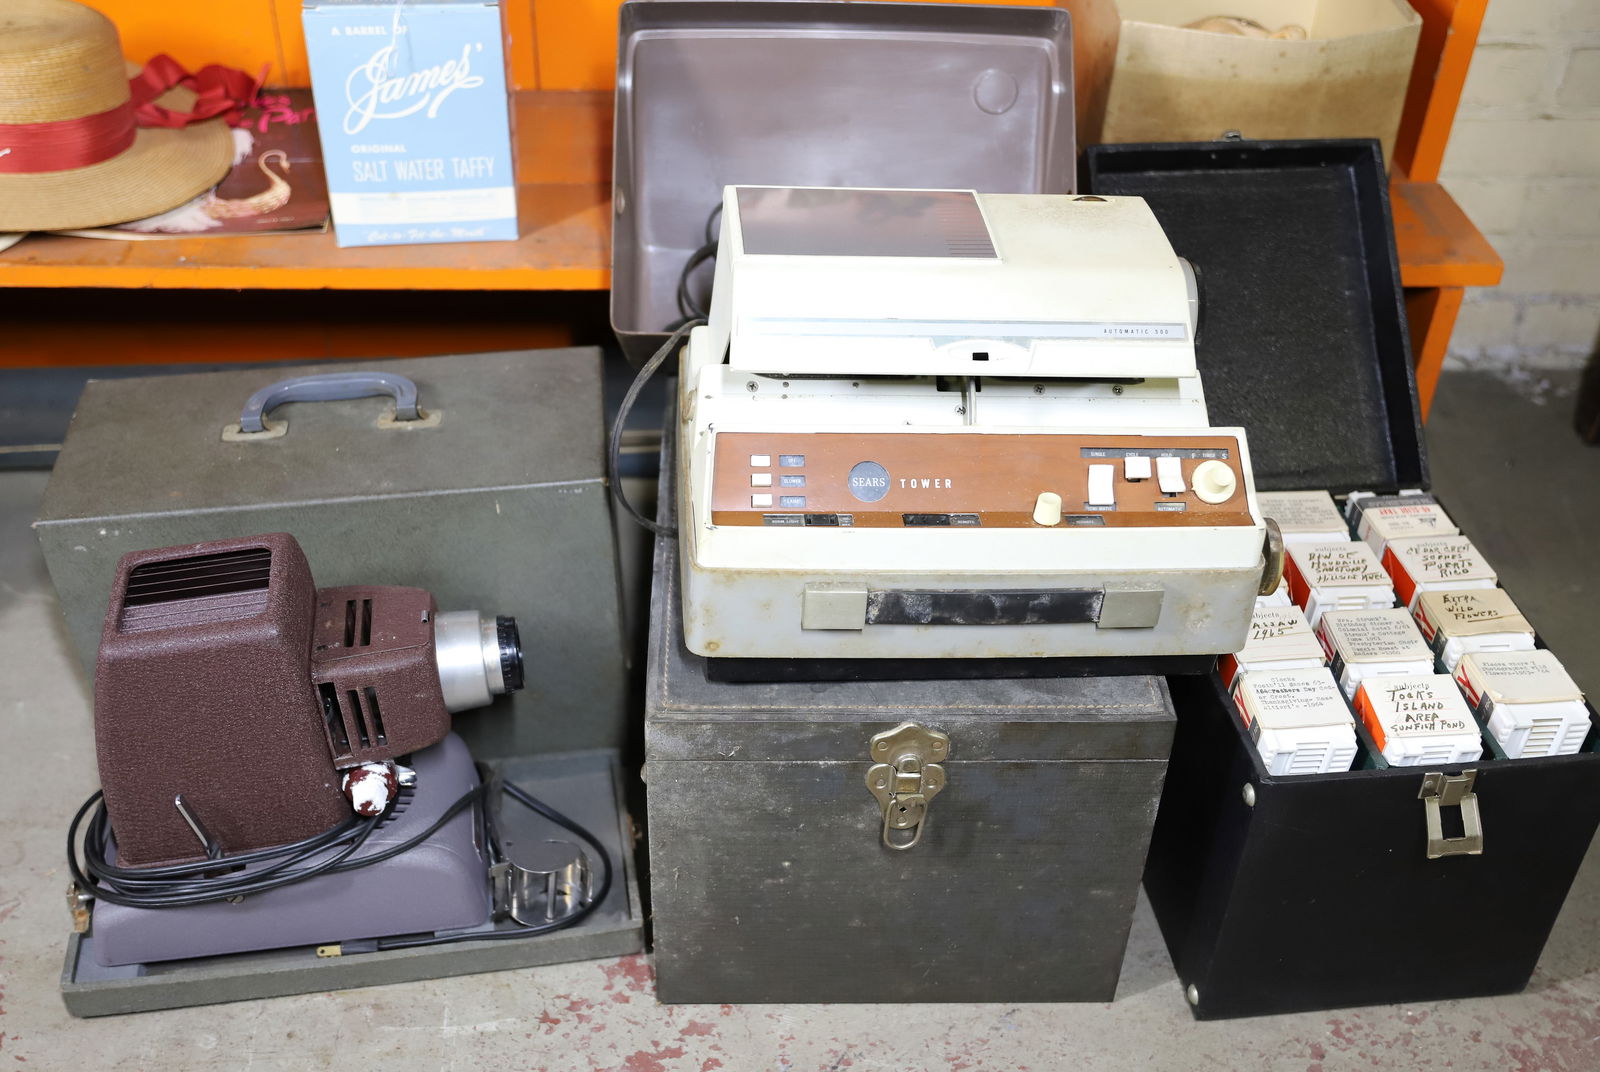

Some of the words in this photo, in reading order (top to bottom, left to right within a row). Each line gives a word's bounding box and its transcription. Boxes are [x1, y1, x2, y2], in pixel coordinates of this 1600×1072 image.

[331, 27, 341, 36] A
[345, 26, 387, 36] BARREL
[351, 144, 407, 153] ORIGINAL
[352, 160, 388, 182] SALT
[393, 158, 445, 181] WATER
[451, 157, 495, 179] TAFFY
[852, 477, 886, 487] SEARS
[900, 478, 952, 489] TOWER
[1440, 568, 1469, 578] RICO
[1443, 594, 1477, 606] EXTRA
[1454, 610, 1498, 620] FLOWERS
[1394, 682, 1430, 691] subjects
[1395, 701, 1444, 712] ISLAND
[1405, 712, 1440, 723] AREA
[1390, 722, 1436, 732] SUNFISH
[1440, 720, 1466, 730] POND
